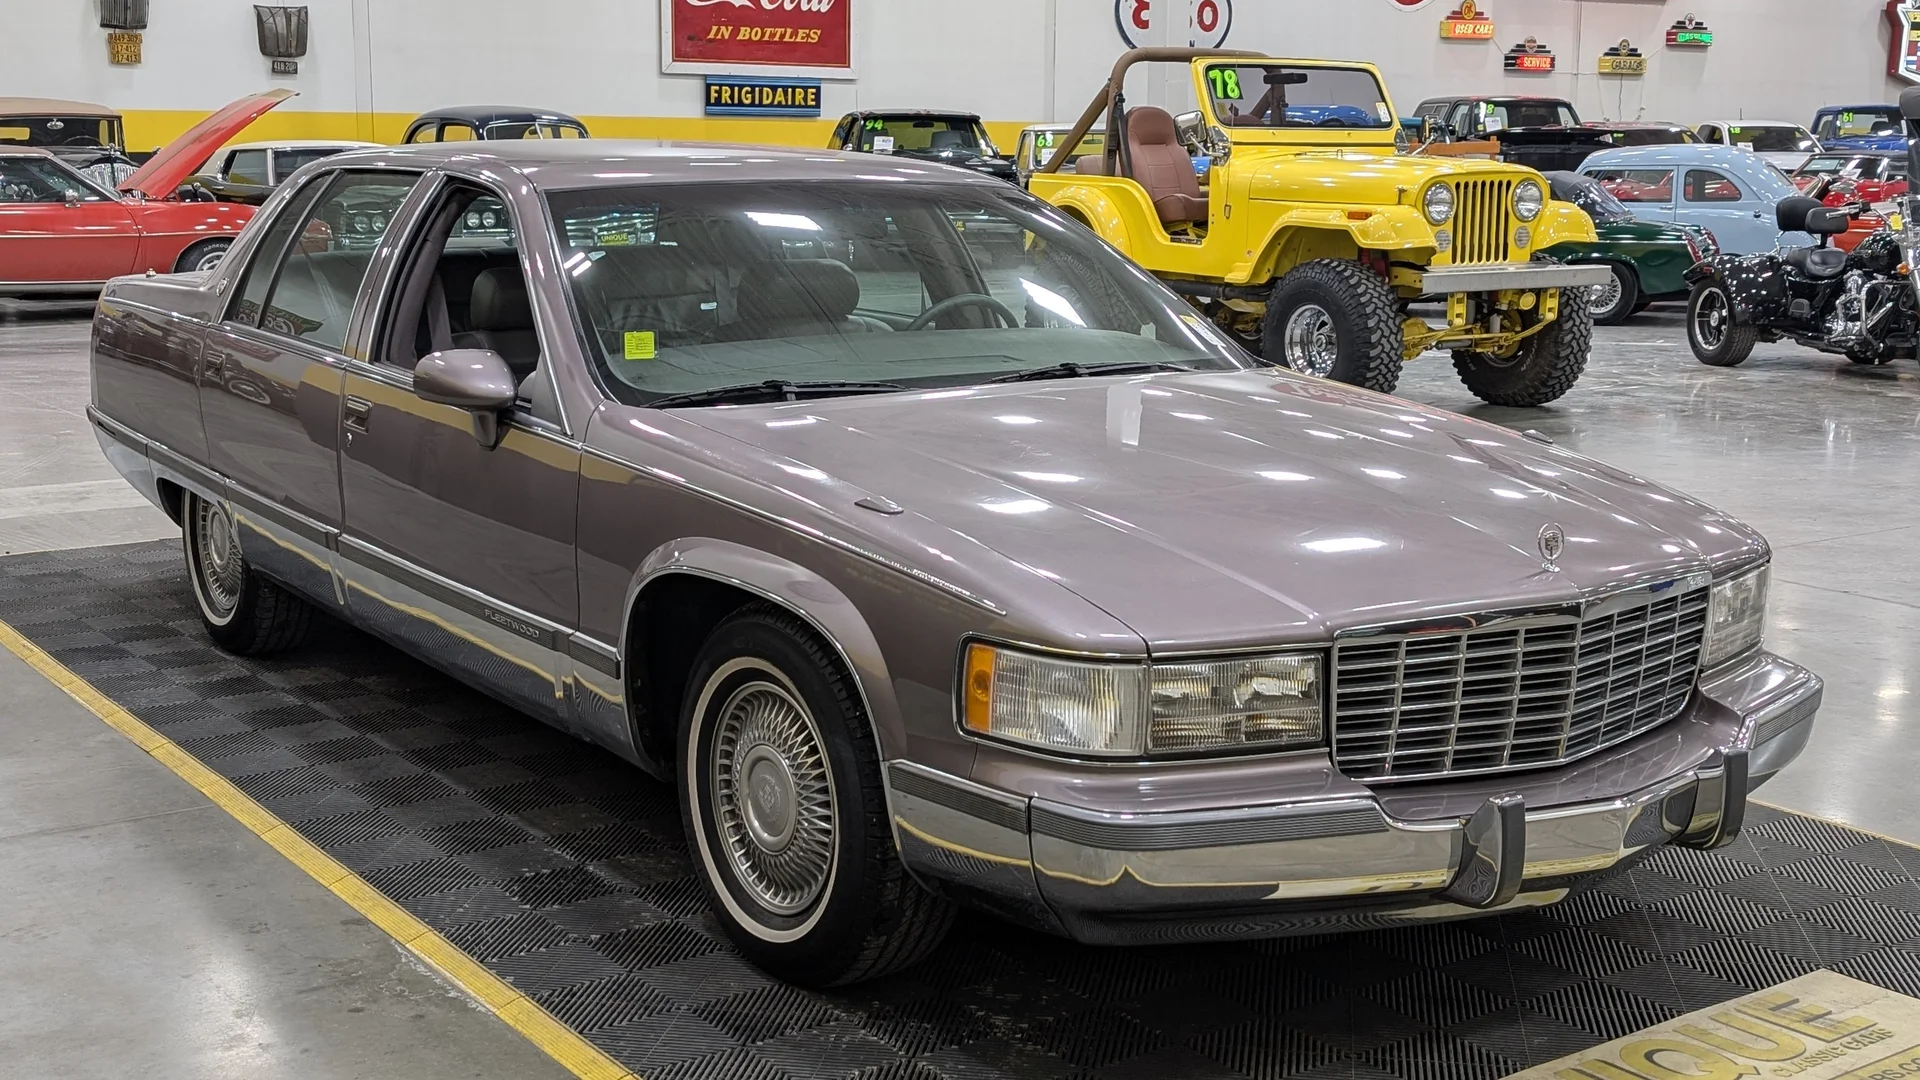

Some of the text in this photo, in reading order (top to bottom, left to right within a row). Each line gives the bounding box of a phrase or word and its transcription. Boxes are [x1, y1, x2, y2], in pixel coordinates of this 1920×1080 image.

[707, 25, 821, 43] IN BOTTLES
[1455, 24, 1494, 34] USED CARS
[1523, 56, 1551, 68] SERVICE
[1208, 69, 1240, 99] 78
[710, 86, 817, 106] FRIGIDAIRE
[865, 119, 883, 130] 94
[1843, 112, 1853, 122] 61
[1037, 132, 1053, 147] 68
[601, 233, 628, 241] UNIQUE
[484, 608, 540, 638] FLEETWOOD
[1770, 1028, 1895, 1078] CLASSIC CARS
